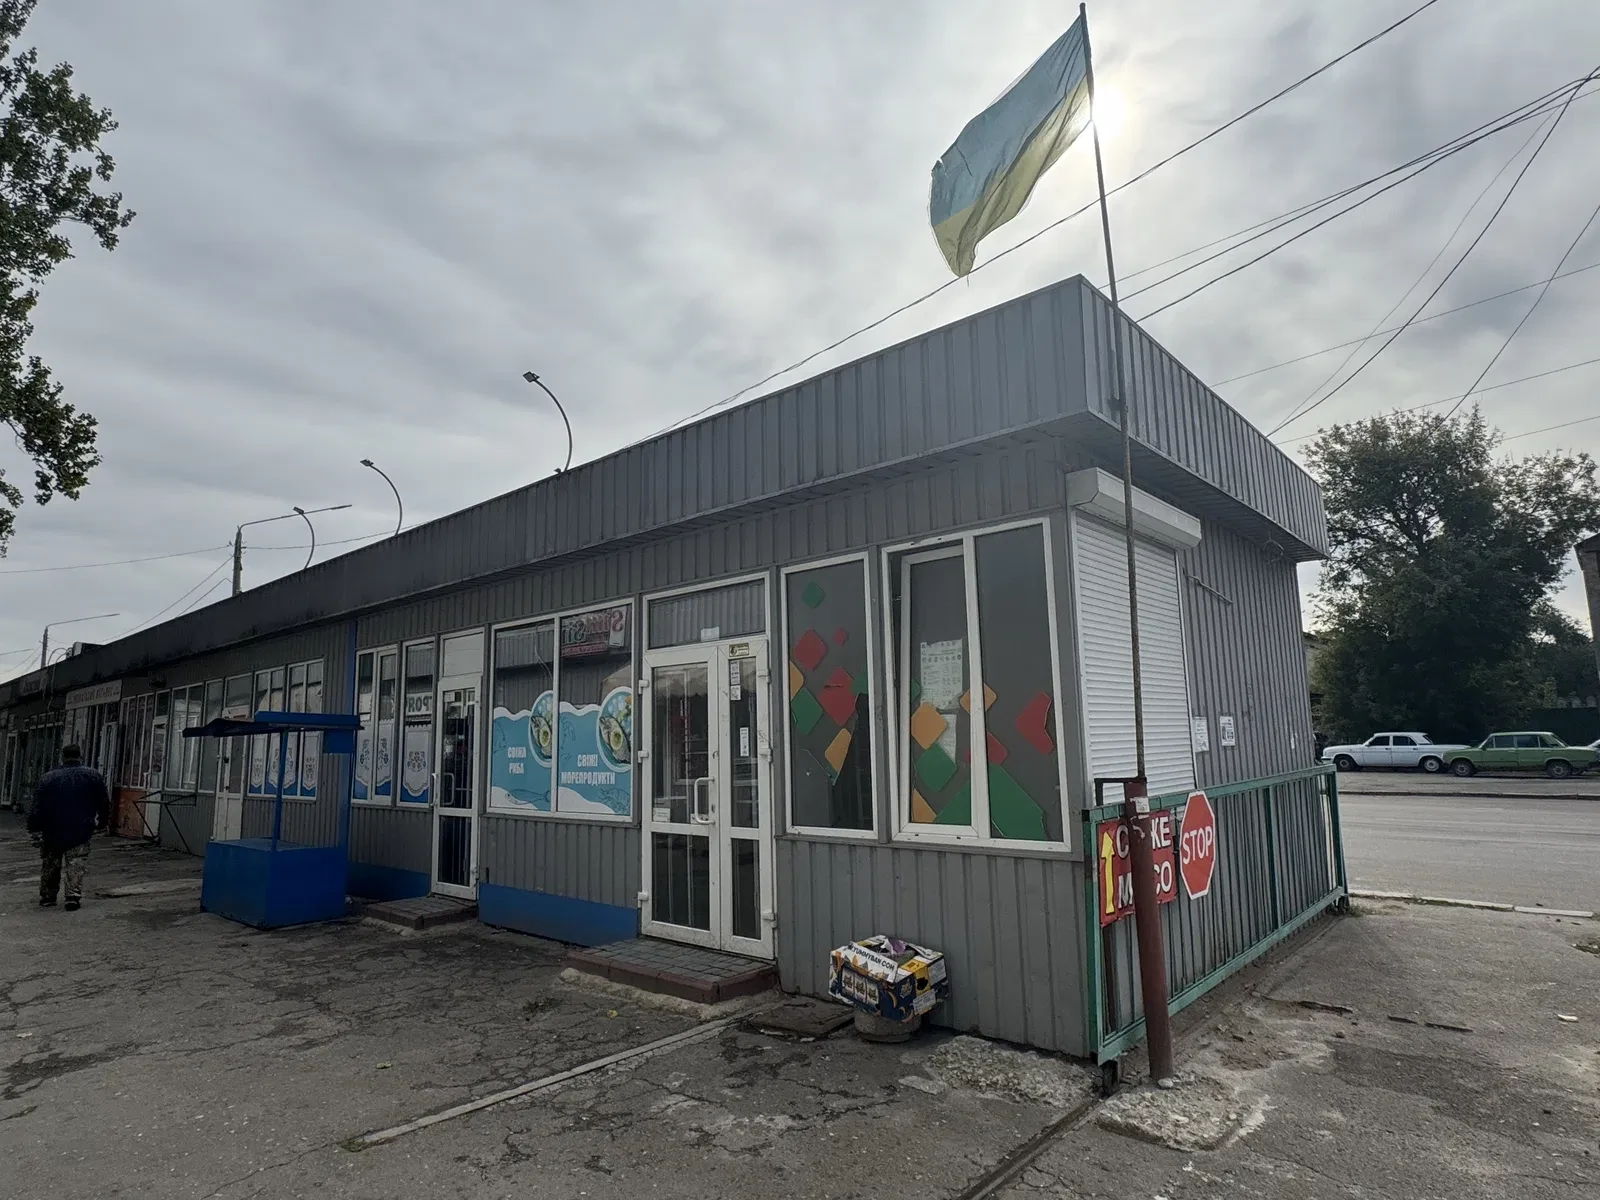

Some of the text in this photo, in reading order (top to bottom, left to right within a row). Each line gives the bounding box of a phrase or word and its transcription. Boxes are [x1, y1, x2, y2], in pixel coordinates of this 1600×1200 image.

[577, 754, 598, 767] СВІЖІ
[508, 763, 525, 774] РИБА
[561, 771, 616, 786] МОРЕПРОДУКТИ
[1182, 825, 1213, 865] STOP
